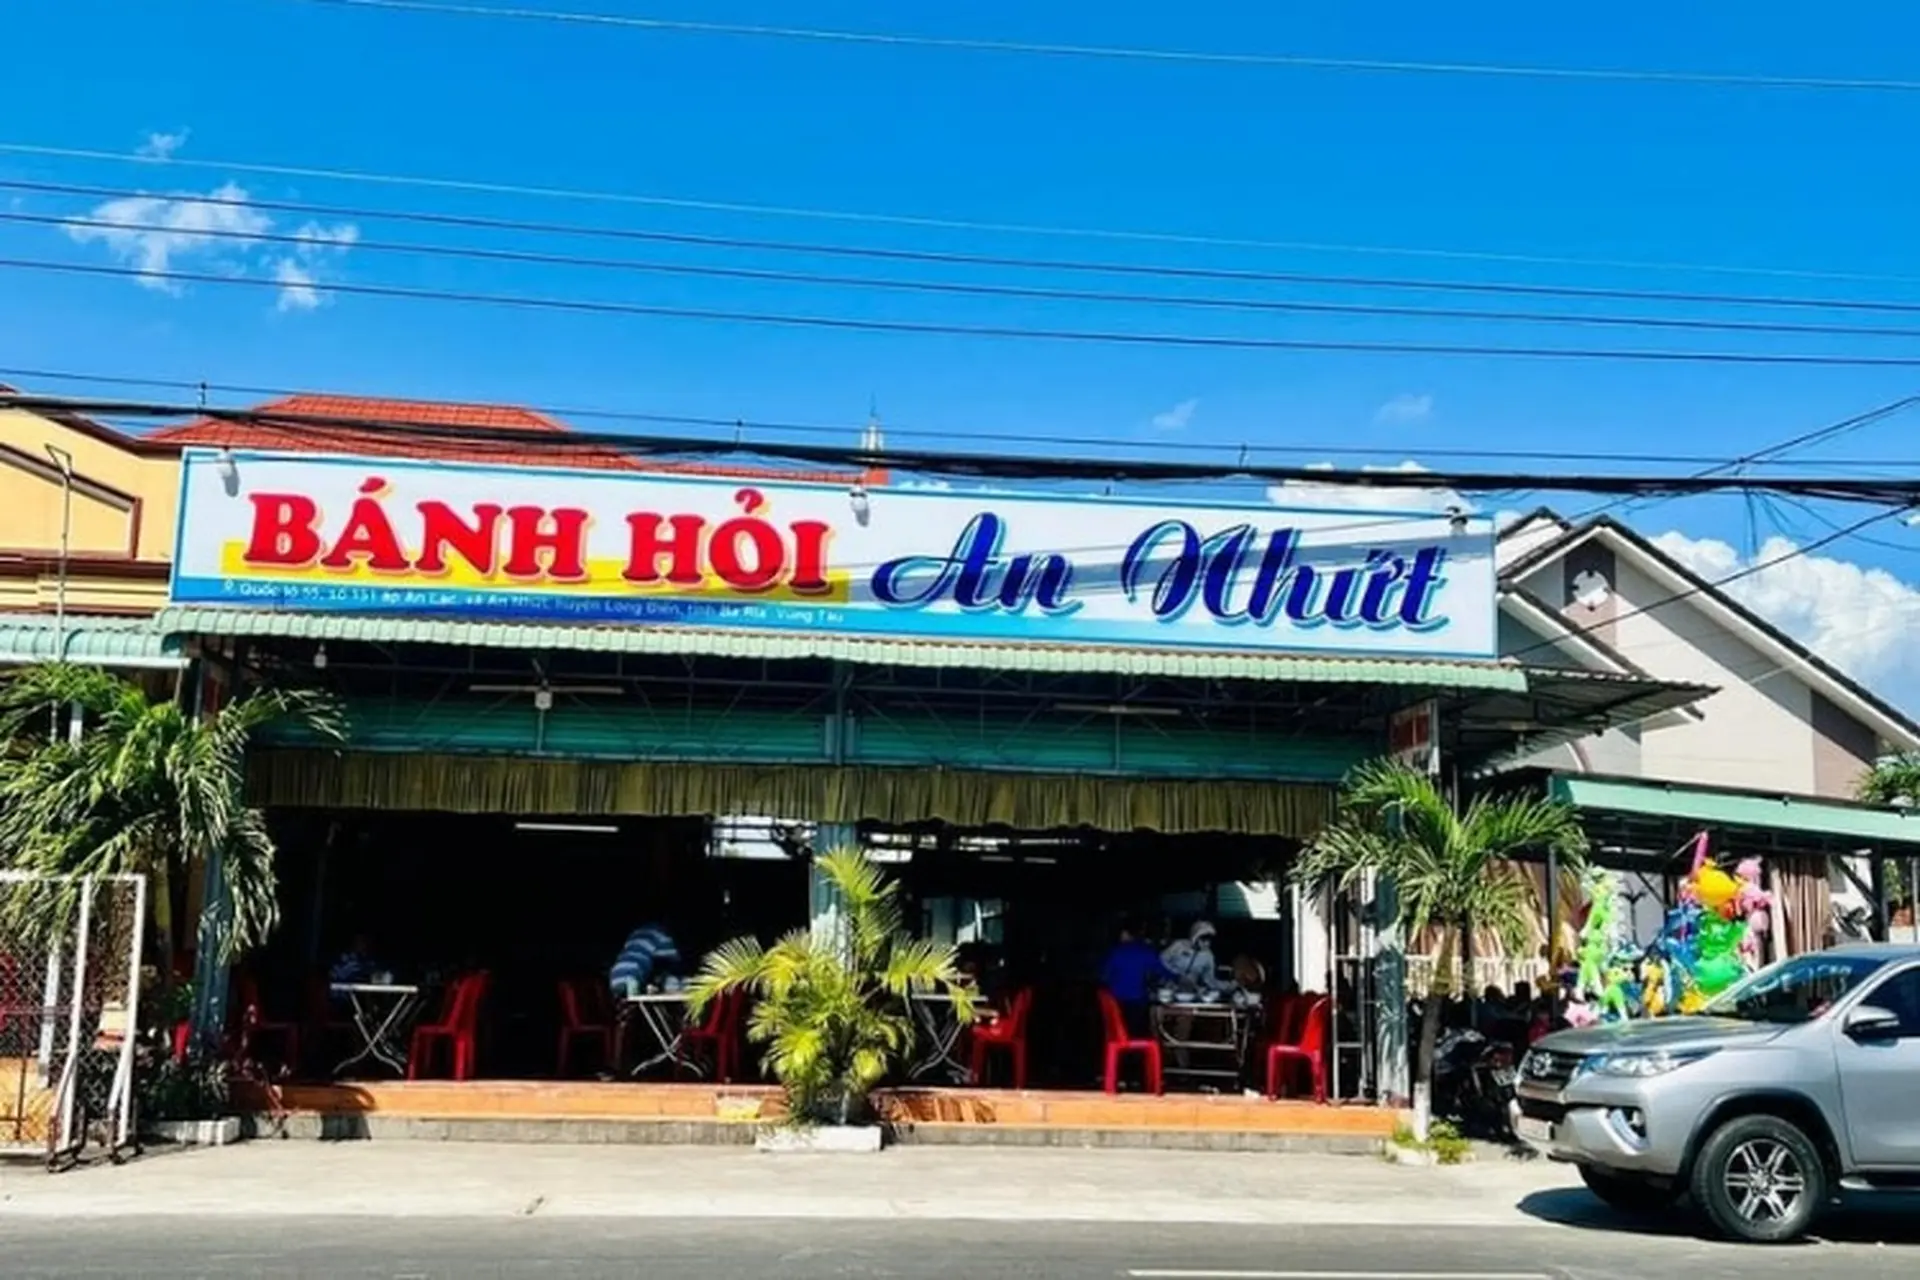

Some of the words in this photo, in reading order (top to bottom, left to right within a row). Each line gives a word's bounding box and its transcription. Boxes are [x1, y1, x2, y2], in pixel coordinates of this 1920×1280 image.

[243, 476, 590, 580] BÁNH
[622, 488, 834, 595] HỎI
[871, 512, 1084, 615] An
[1120, 519, 1448, 633] Nhứt
